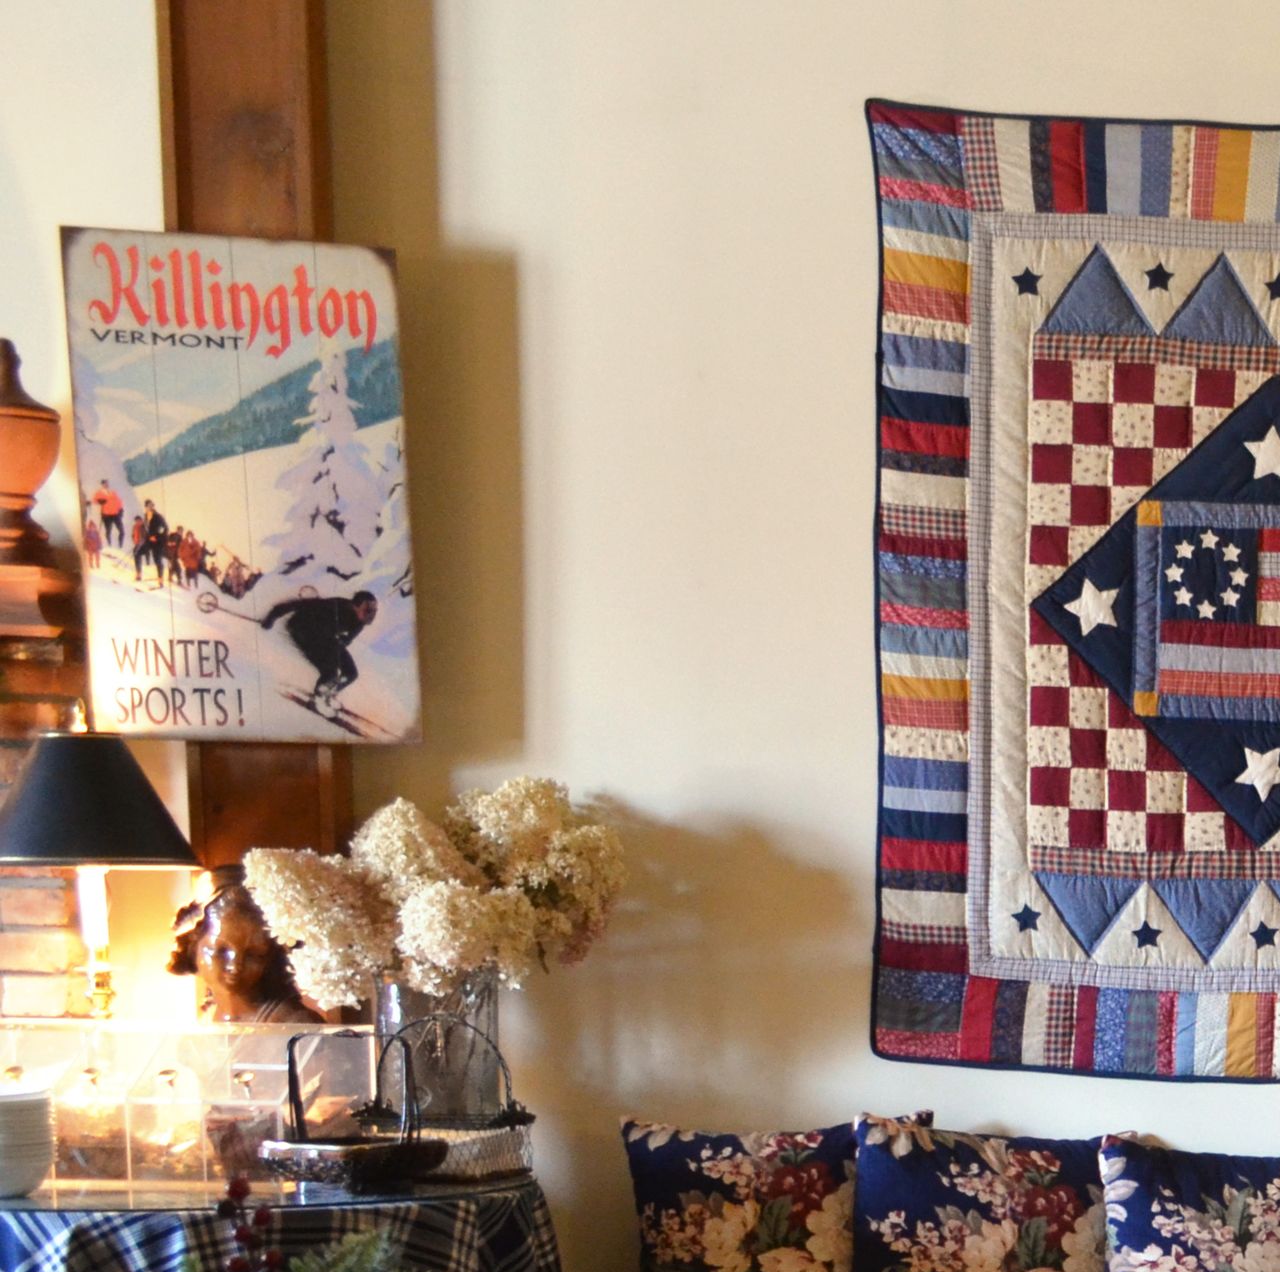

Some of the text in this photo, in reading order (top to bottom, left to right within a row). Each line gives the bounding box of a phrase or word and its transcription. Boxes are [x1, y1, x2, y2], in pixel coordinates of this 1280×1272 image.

[88, 242, 378, 359] Killington
[90, 328, 245, 352] VERMONT
[111, 637, 234, 679] WINTER
[114, 686, 246, 727] SPORTS!
